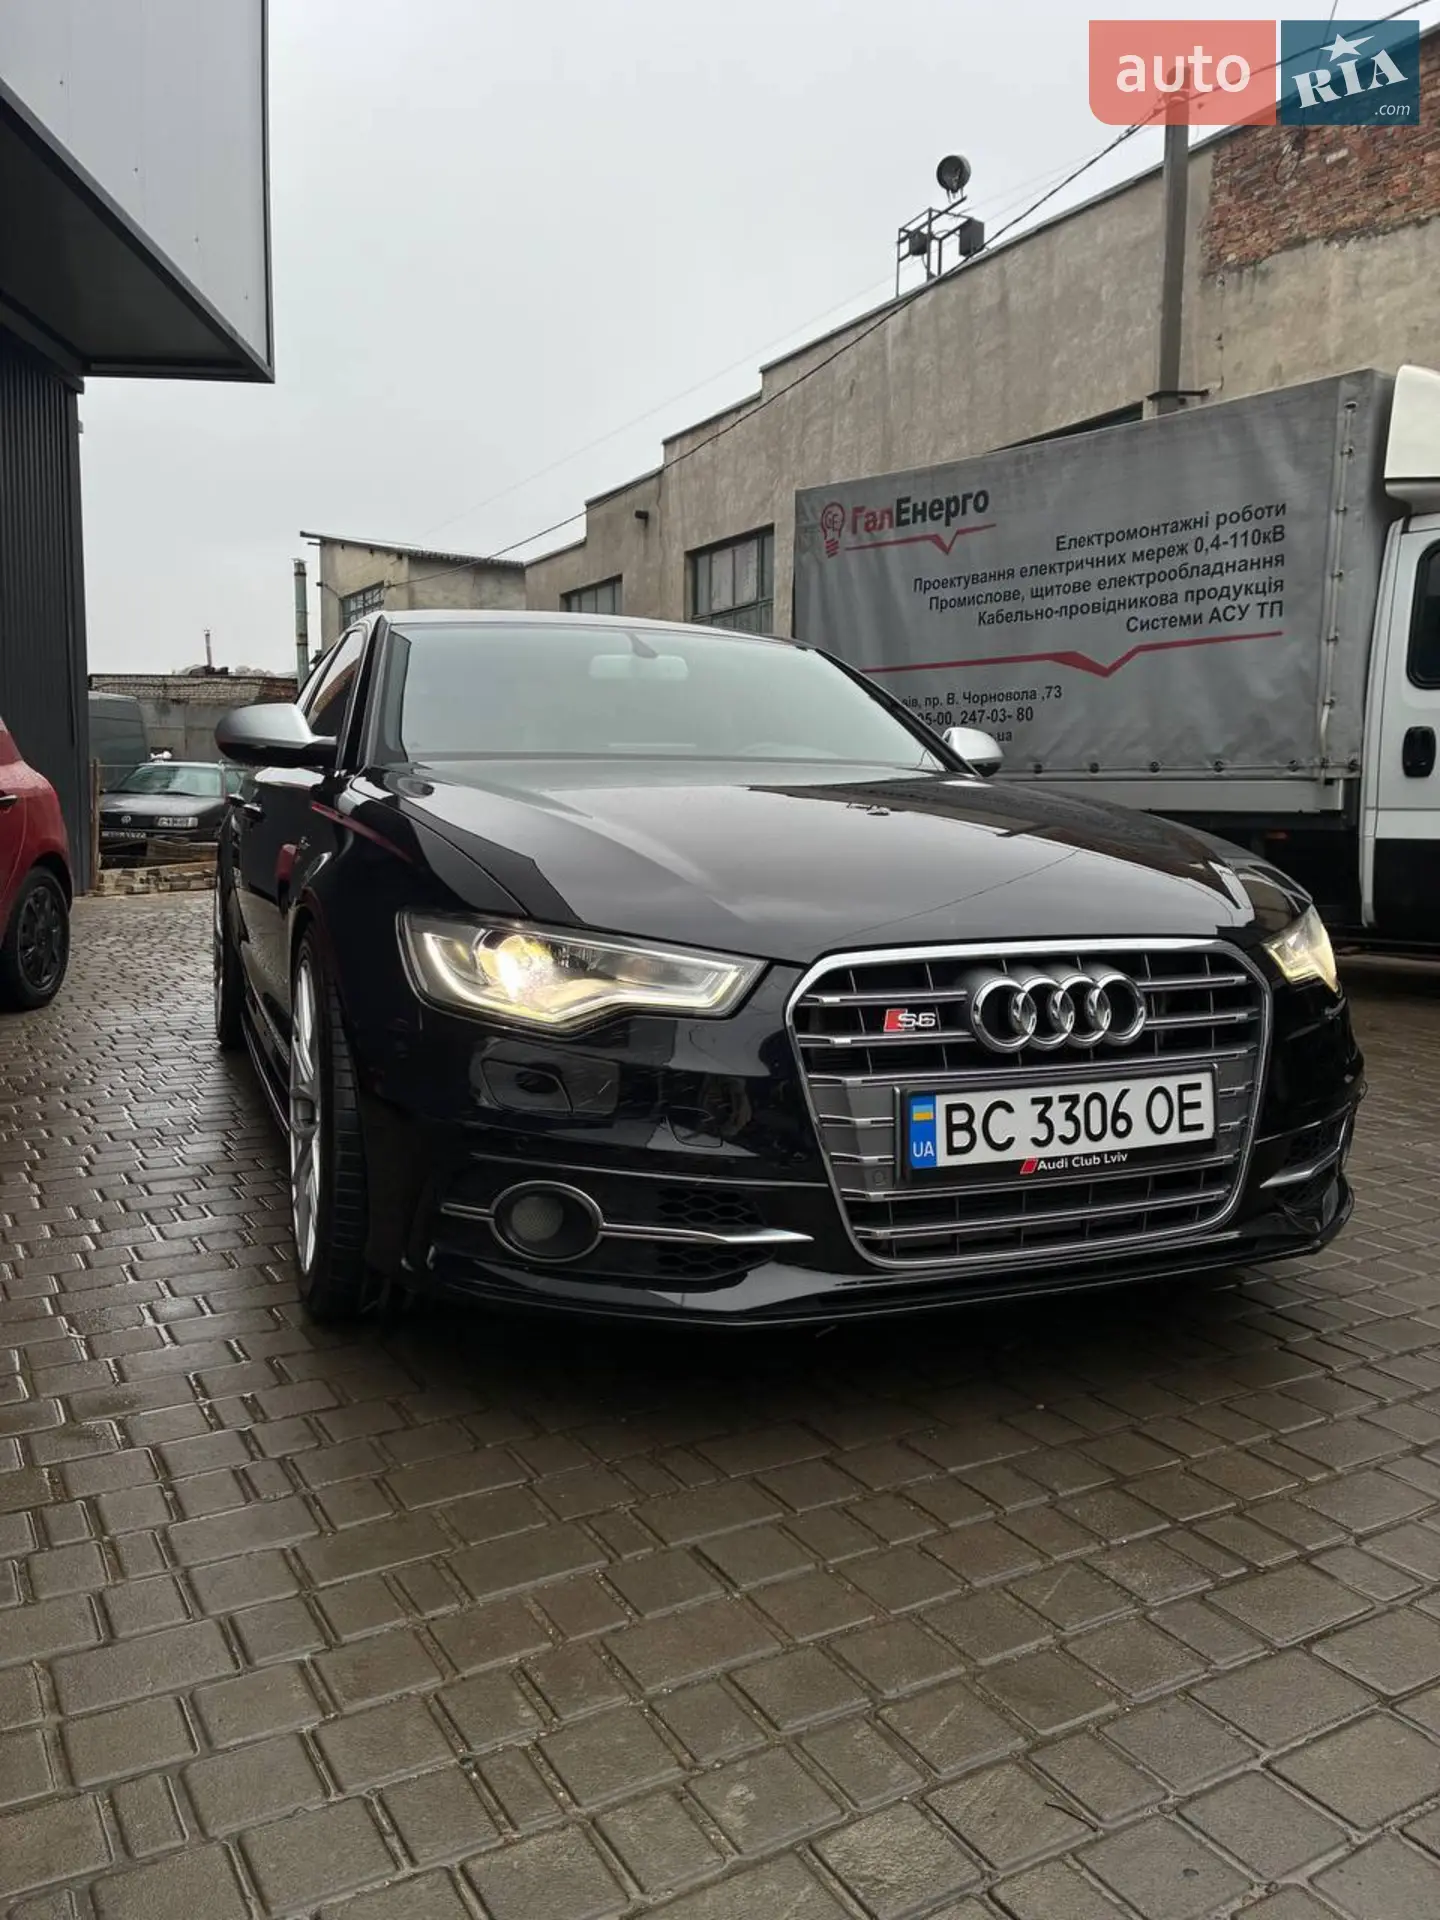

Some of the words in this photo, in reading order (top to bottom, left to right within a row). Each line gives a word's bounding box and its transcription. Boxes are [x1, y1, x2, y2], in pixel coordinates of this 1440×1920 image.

[851, 489, 990, 536] ГалЕнерго
[1055, 511, 1210, 551] Електромонтажні
[1215, 502, 1287, 530] роботи
[913, 567, 1016, 594] Проектування
[1019, 551, 1127, 578] електричних
[1131, 542, 1190, 566] мереж
[1193, 523, 1286, 555] 0,4-110кВ
[929, 588, 1026, 613] Промислове,
[1030, 579, 1092, 600] щитове
[1097, 553, 1286, 592] електрообладнання
[978, 593, 1180, 627] Кабельно-провідникова
[1184, 576, 1285, 604] продукція
[1126, 614, 1204, 633] Системи
[1208, 603, 1251, 625] АСУ
[1256, 600, 1284, 619] ТП
[924, 695, 943, 709] пр.
[946, 692, 960, 706] В.
[962, 689, 1038, 707] Чорновола
[898, 1012, 936, 1028] S6
[945, 1100, 1016, 1156] BC
[1029, 1088, 1133, 1149] 3306
[1145, 1082, 1205, 1136] OE
[912, 1139, 935, 1159] UA
[1036, 1157, 1069, 1172] Audi
[1071, 1153, 1101, 1169] Club
[1103, 1151, 1129, 1165] Lviv
